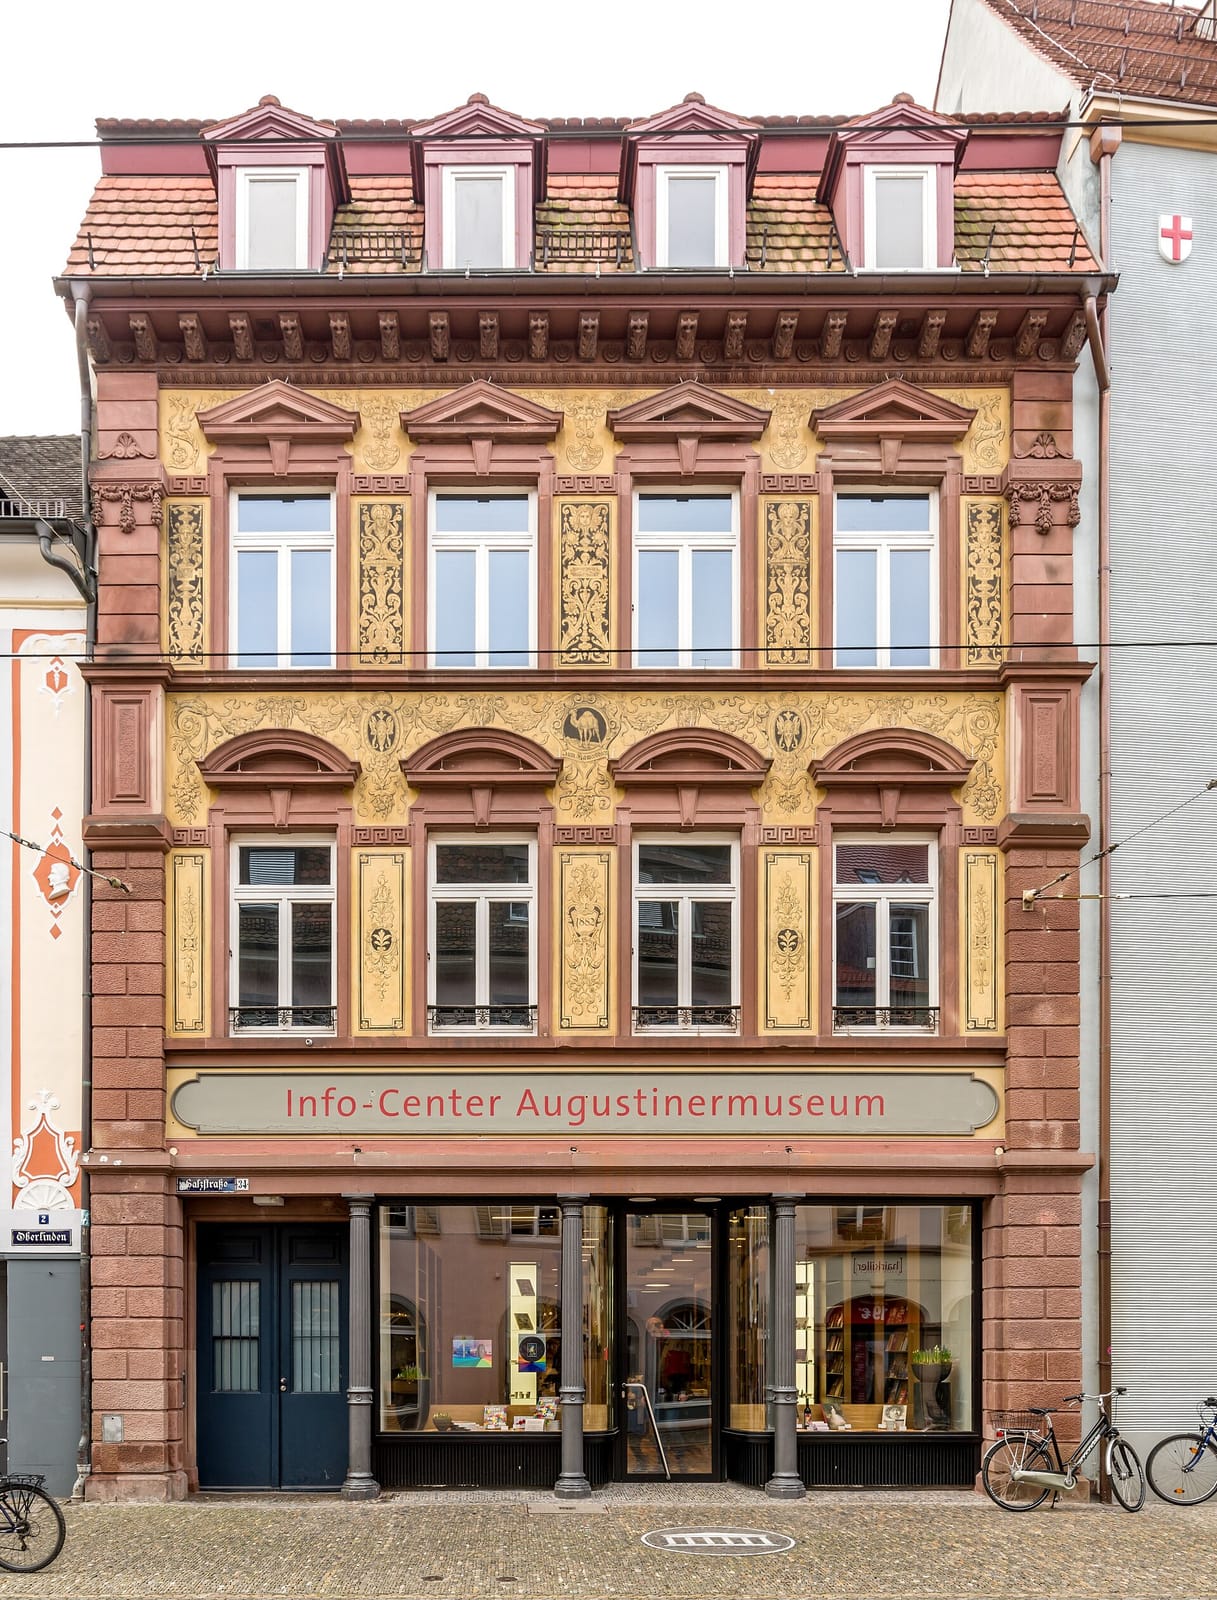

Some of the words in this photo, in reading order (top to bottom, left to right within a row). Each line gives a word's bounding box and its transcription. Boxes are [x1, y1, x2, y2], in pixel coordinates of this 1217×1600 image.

[576, 917, 596, 929] 1882
[287, 1087, 501, 1117] Info-Center
[516, 1087, 885, 1126] Augustinermuseum
[40, 1215, 47, 1223] 2
[16, 1231, 67, 1241] Oberlinden
